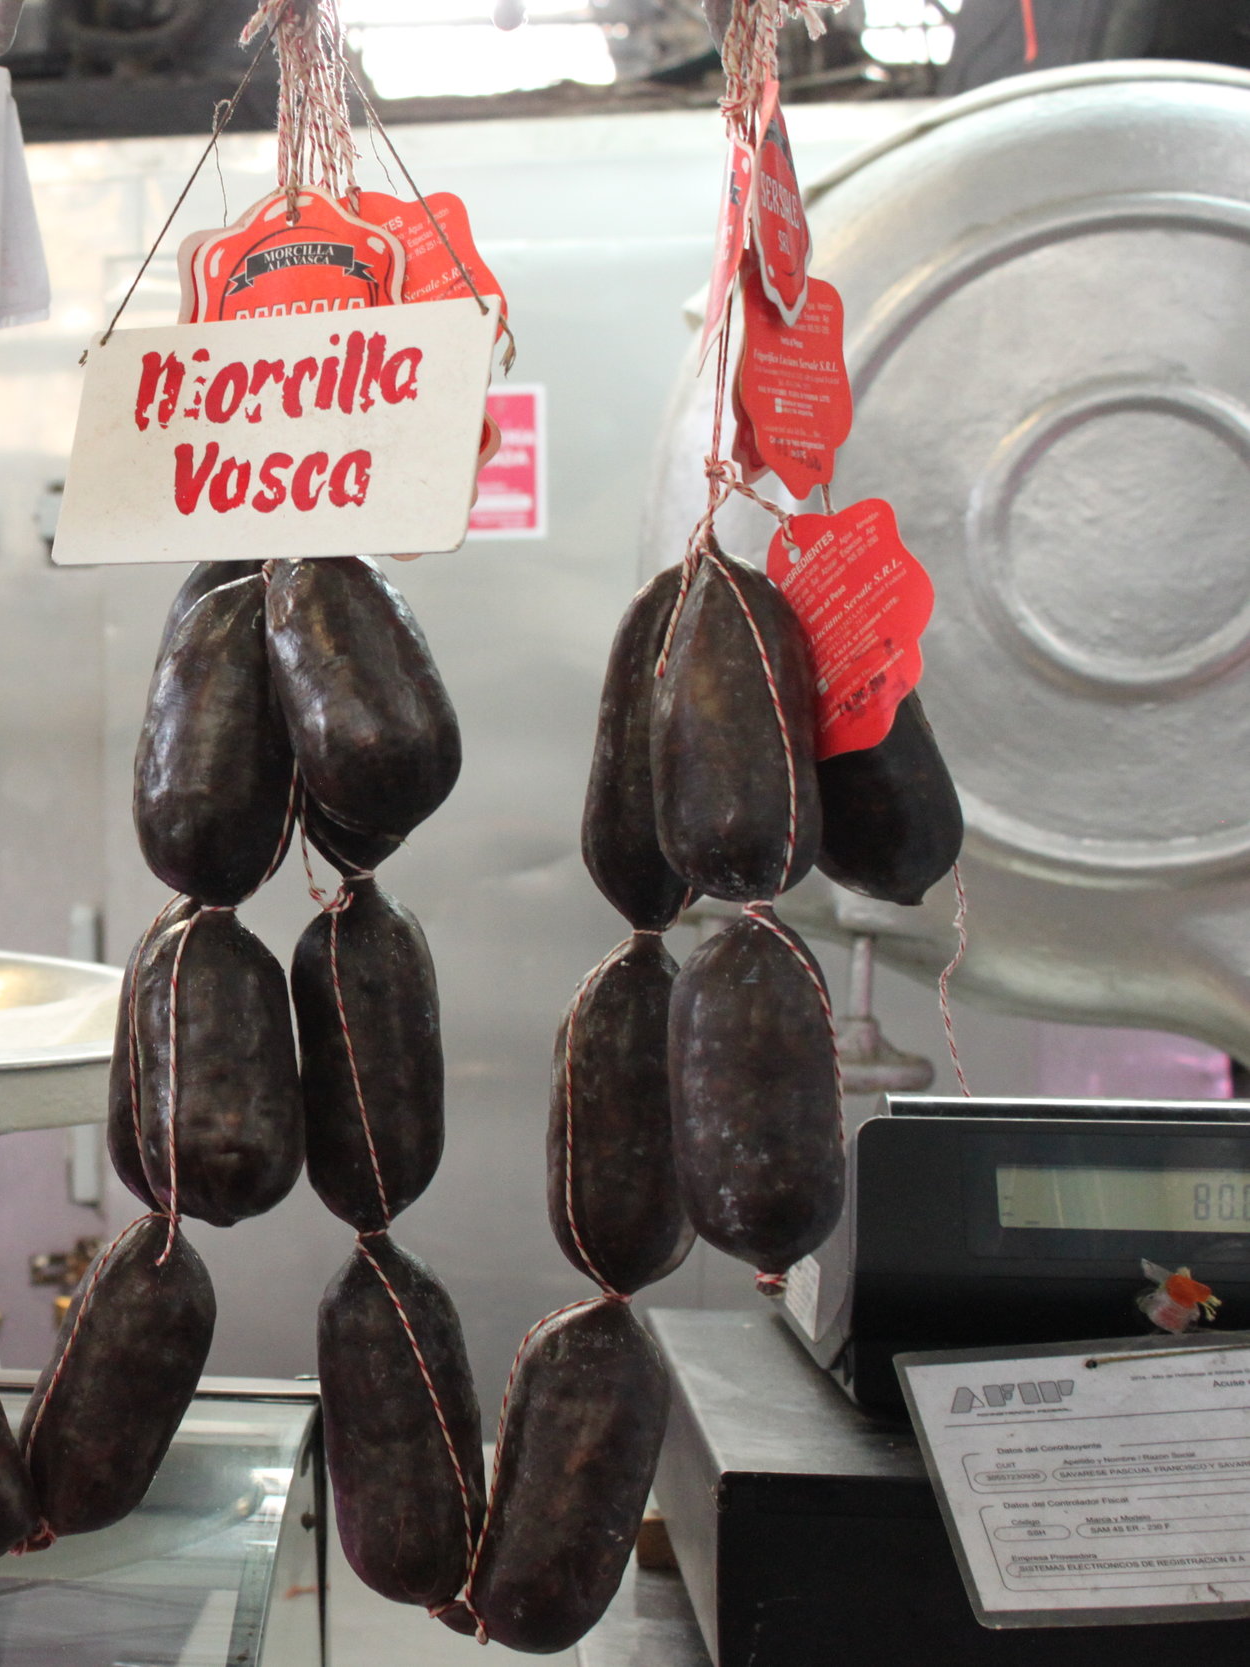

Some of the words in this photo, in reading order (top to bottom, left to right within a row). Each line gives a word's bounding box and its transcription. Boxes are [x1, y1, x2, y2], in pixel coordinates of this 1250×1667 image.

[264, 245, 334, 263] MORCILLA
[293, 255, 330, 266] VASCA
[403, 280, 440, 303] Sersale
[135, 331, 423, 432] Morcilla
[175, 441, 373, 516] Vasca
[781, 530, 835, 593] INGREDIENTES
[843, 582, 873, 611] Sersale
[873, 558, 902, 582] S.R.L.
[1213, 1379, 1245, 1388] Acuse
[997, 1447, 1023, 1455] Datos
[1025, 1446, 1038, 1454] del
[1040, 1442, 1102, 1453] Contribuyente
[1059, 1469, 1107, 1478] SAVARESE
[1110, 1466, 1151, 1475] PASCUAL
[1154, 1462, 1208, 1473] FRANCISCO
[1003, 1500, 1029, 1509] Datos
[1031, 1500, 1046, 1508] del
[1047, 1498, 1099, 1508] Controlador
[1102, 1496, 1129, 1505] Fiscal
[1120, 1513, 1151, 1521] Modelo
[1090, 1526, 1110, 1534] SAM
[1126, 1524, 1139, 1532] ER
[1011, 1553, 1048, 1562] Empresa
[1050, 1552, 1098, 1560] Proveedora
[1018, 1564, 1065, 1573] SISTEMAS
[1067, 1560, 1140, 1572] ELECTRONICOS
[1142, 1560, 1156, 1568] DE
[1157, 1557, 1228, 1567] REGISTRACION
